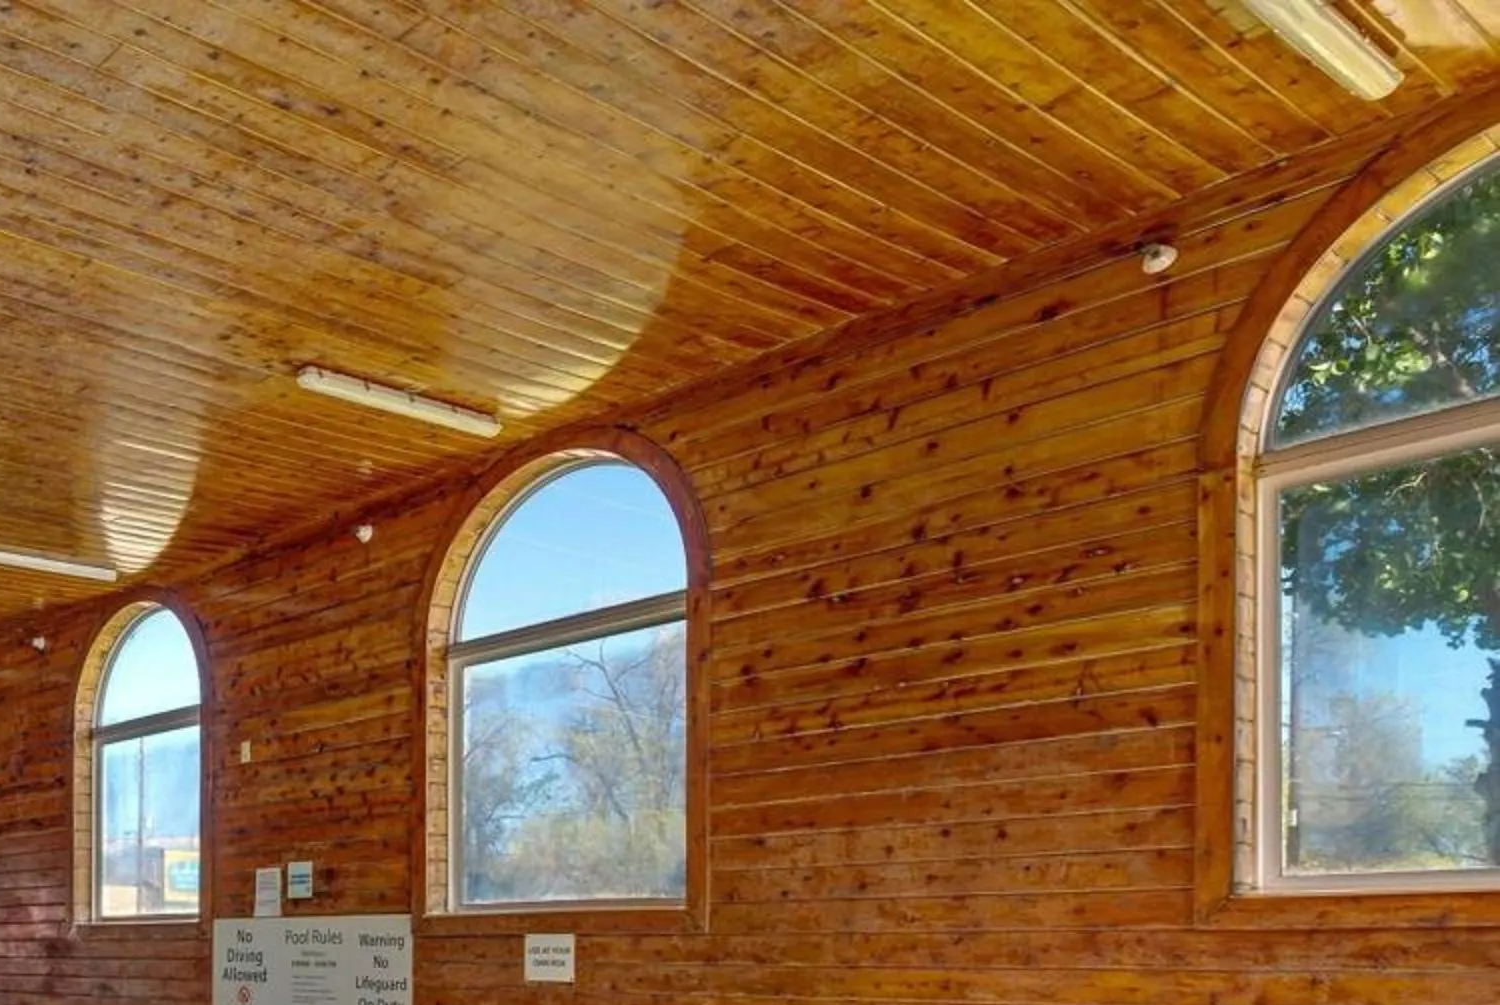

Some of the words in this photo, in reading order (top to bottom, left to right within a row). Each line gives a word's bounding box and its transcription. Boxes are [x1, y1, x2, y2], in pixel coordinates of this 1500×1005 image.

[237, 930, 253, 943] No
[285, 929, 309, 945] Pool
[311, 928, 343, 945] Rules
[358, 934, 405, 951] Warning
[226, 948, 263, 967] Diving
[373, 955, 389, 969] No
[222, 967, 268, 983] Allowed
[355, 976, 407, 994] Lifeguard
